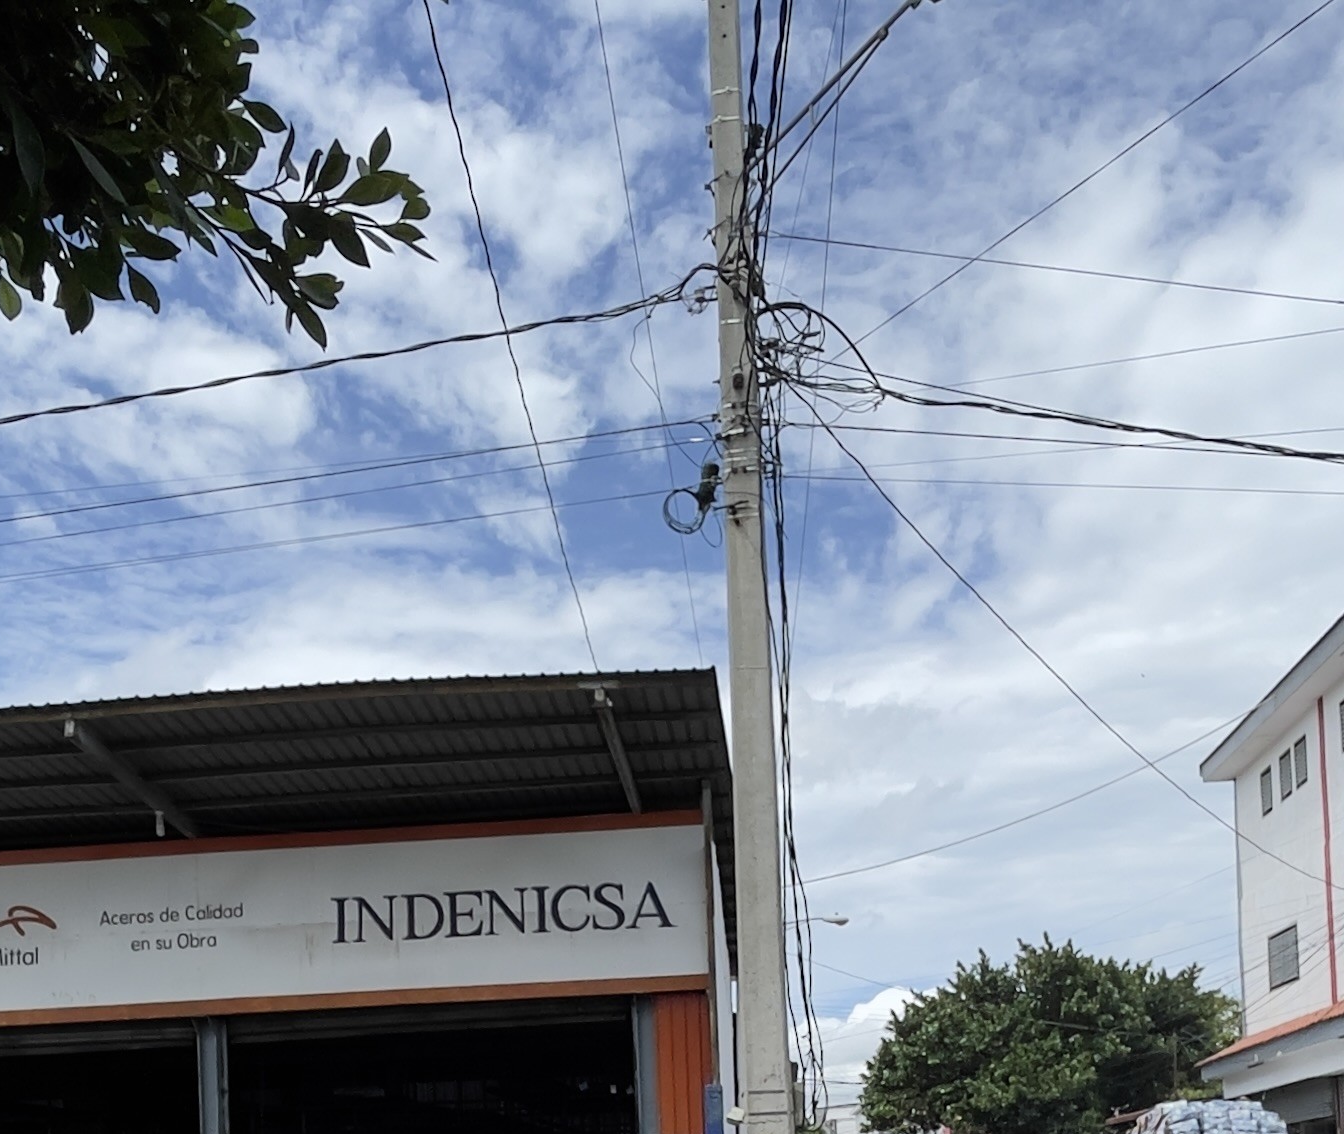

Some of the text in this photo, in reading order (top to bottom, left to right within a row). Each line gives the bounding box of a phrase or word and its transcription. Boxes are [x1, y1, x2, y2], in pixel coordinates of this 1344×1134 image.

[100, 902, 244, 926] Aceros de Calidad
[330, 881, 678, 944] INDENICSA
[130, 933, 217, 951] en su Obra
